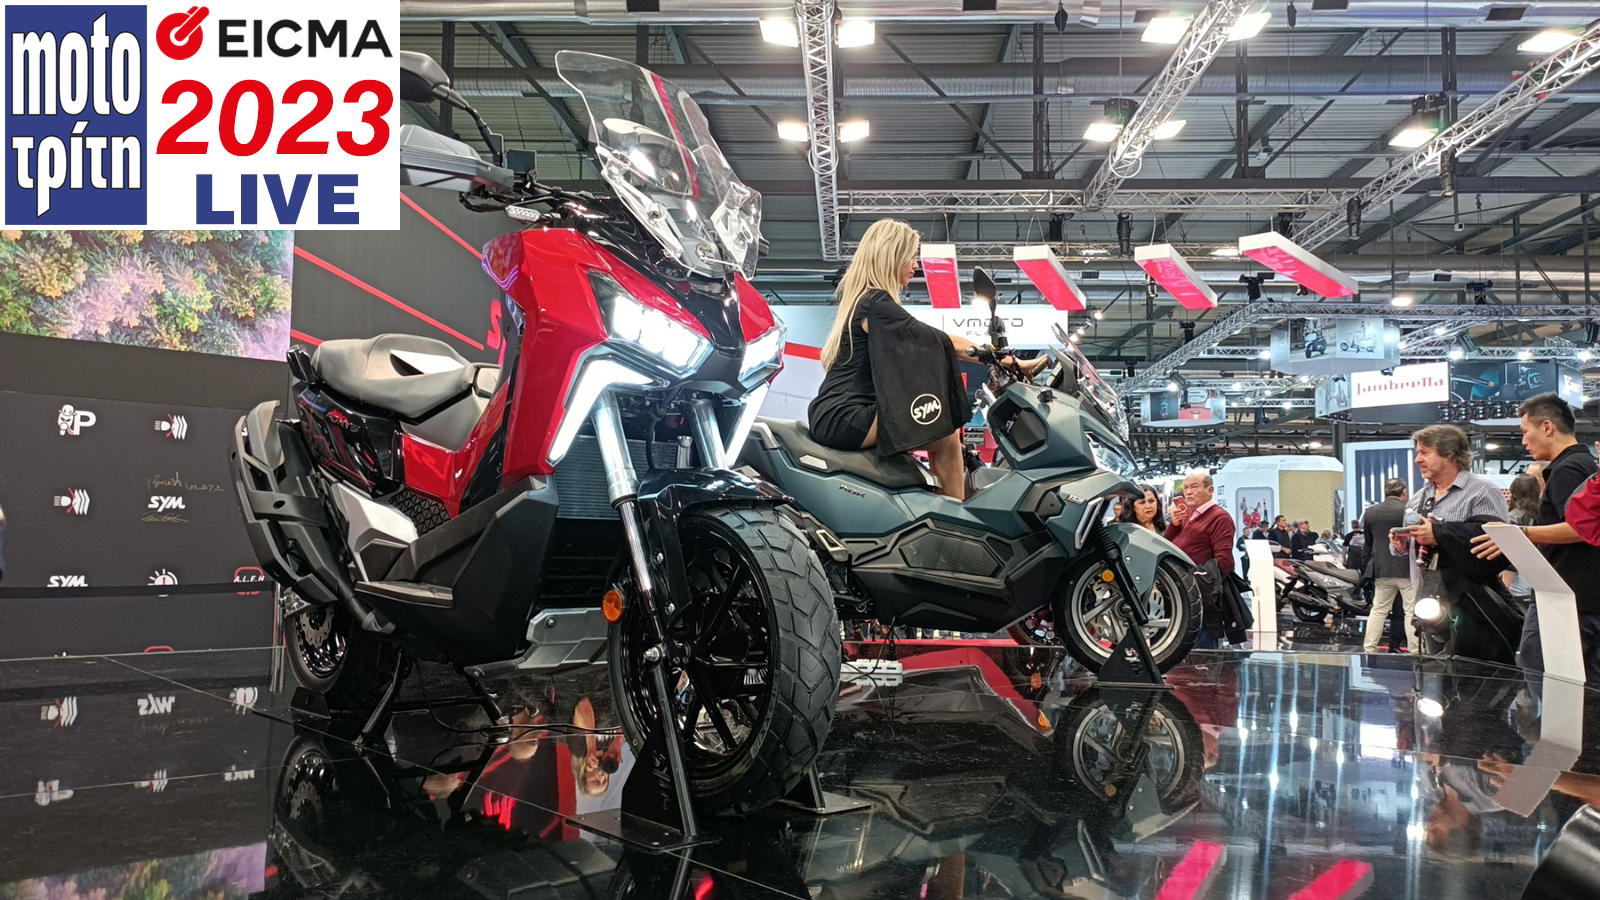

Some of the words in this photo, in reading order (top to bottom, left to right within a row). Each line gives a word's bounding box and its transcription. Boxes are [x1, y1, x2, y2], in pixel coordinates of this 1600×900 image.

[913, 399, 941, 419] SYM
[147, 495, 187, 513] SYM
[46, 574, 89, 588] SYM
